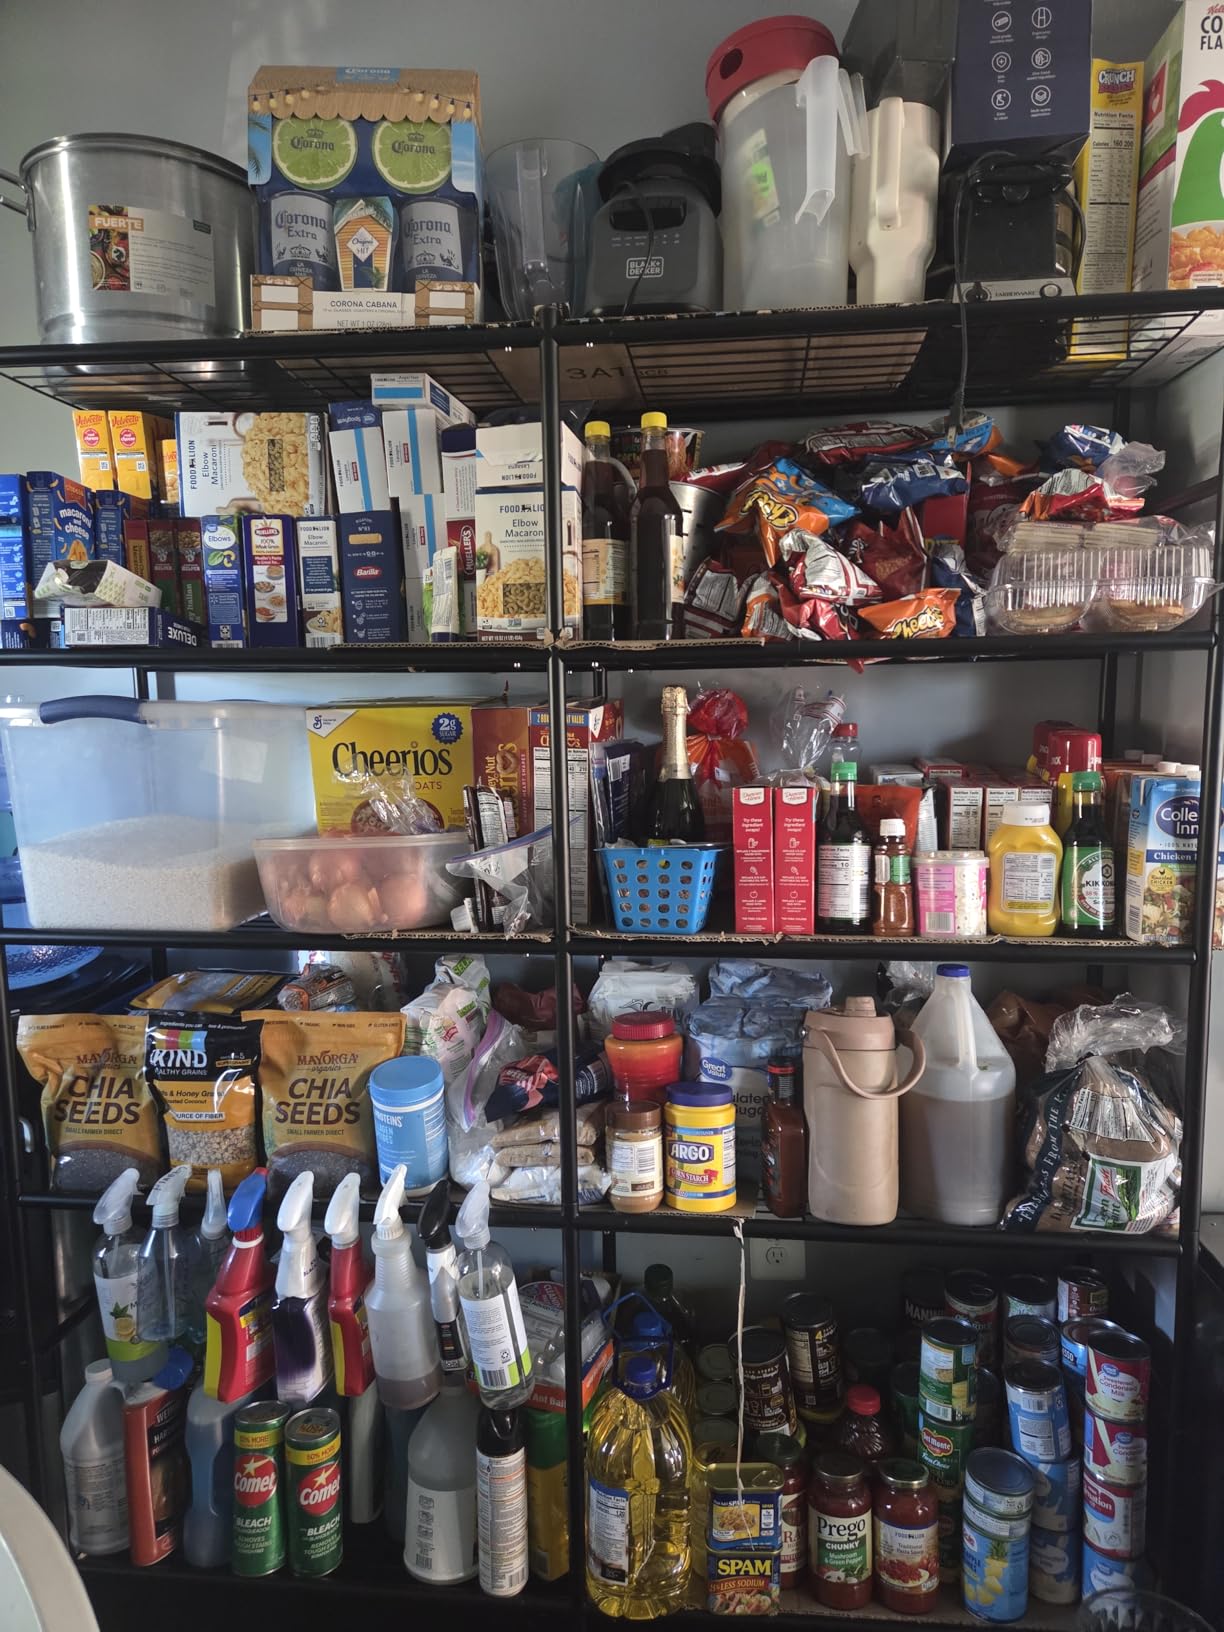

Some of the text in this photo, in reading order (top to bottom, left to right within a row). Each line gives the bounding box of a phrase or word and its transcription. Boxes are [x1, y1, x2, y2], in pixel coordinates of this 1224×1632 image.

[1098, 70, 1136, 85] CRUNCH
[290, 136, 335, 151] Corona
[392, 140, 436, 154] Corona
[95, 217, 143, 230] FUERTE
[275, 210, 328, 230] Corona
[287, 227, 318, 241] Extra
[404, 218, 451, 237] Corona
[413, 233, 442, 246] Extra
[629, 259, 661, 268] BLAK+
[330, 300, 364, 308] CORONA
[188, 440, 197, 490] FOOD LION
[202, 452, 210, 478] Elbow
[500, 505, 545, 513] FOOD LIO
[59, 508, 92, 528] macaroni
[512, 519, 539, 527] Elbow
[65, 522, 90, 540] cheese
[505, 528, 544, 537] Macaron
[356, 568, 380, 576] Barilla
[168, 627, 198, 646] DELUXE
[439, 718, 456, 731] 2g
[332, 741, 453, 777] Cheerios
[485, 755, 496, 773] Nut
[415, 781, 442, 790] OATS
[1160, 808, 1198, 821] Colle
[1176, 821, 1199, 835] Inn
[1153, 852, 1191, 861] Chicken
[77, 1048, 137, 1065] MAYORGA
[150, 1049, 208, 1068] KIND
[297, 1050, 359, 1065] MAYORGA
[702, 1059, 726, 1073] Great
[707, 1067, 727, 1079] Value
[69, 1075, 134, 1099] CHIA
[288, 1078, 352, 1099] CHIA
[732, 1092, 770, 1103] ulated
[54, 1100, 141, 1125] SEEDS
[275, 1101, 360, 1125] SEEDS
[736, 1104, 768, 1118] uga
[670, 1144, 710, 1161] ARGO
[687, 1172, 709, 1182] STARCH
[1099, 1379, 1138, 1392] Condensed
[1111, 1389, 1125, 1397] Milk
[533, 1393, 566, 1408] Ant Bai
[930, 1438, 951, 1450] Monte
[234, 1472, 276, 1493] Comet
[300, 1475, 340, 1506] Comet
[1086, 1490, 1113, 1511] nation
[236, 1515, 272, 1528] BLEACH
[307, 1514, 341, 1536] BLEACH
[817, 1516, 866, 1542] Prego
[825, 1540, 860, 1551] CHUNKY
[829, 1551, 858, 1560] Mushroom
[717, 1559, 772, 1576] SPAM
[720, 1579, 765, 1591] LESS SODIUM
